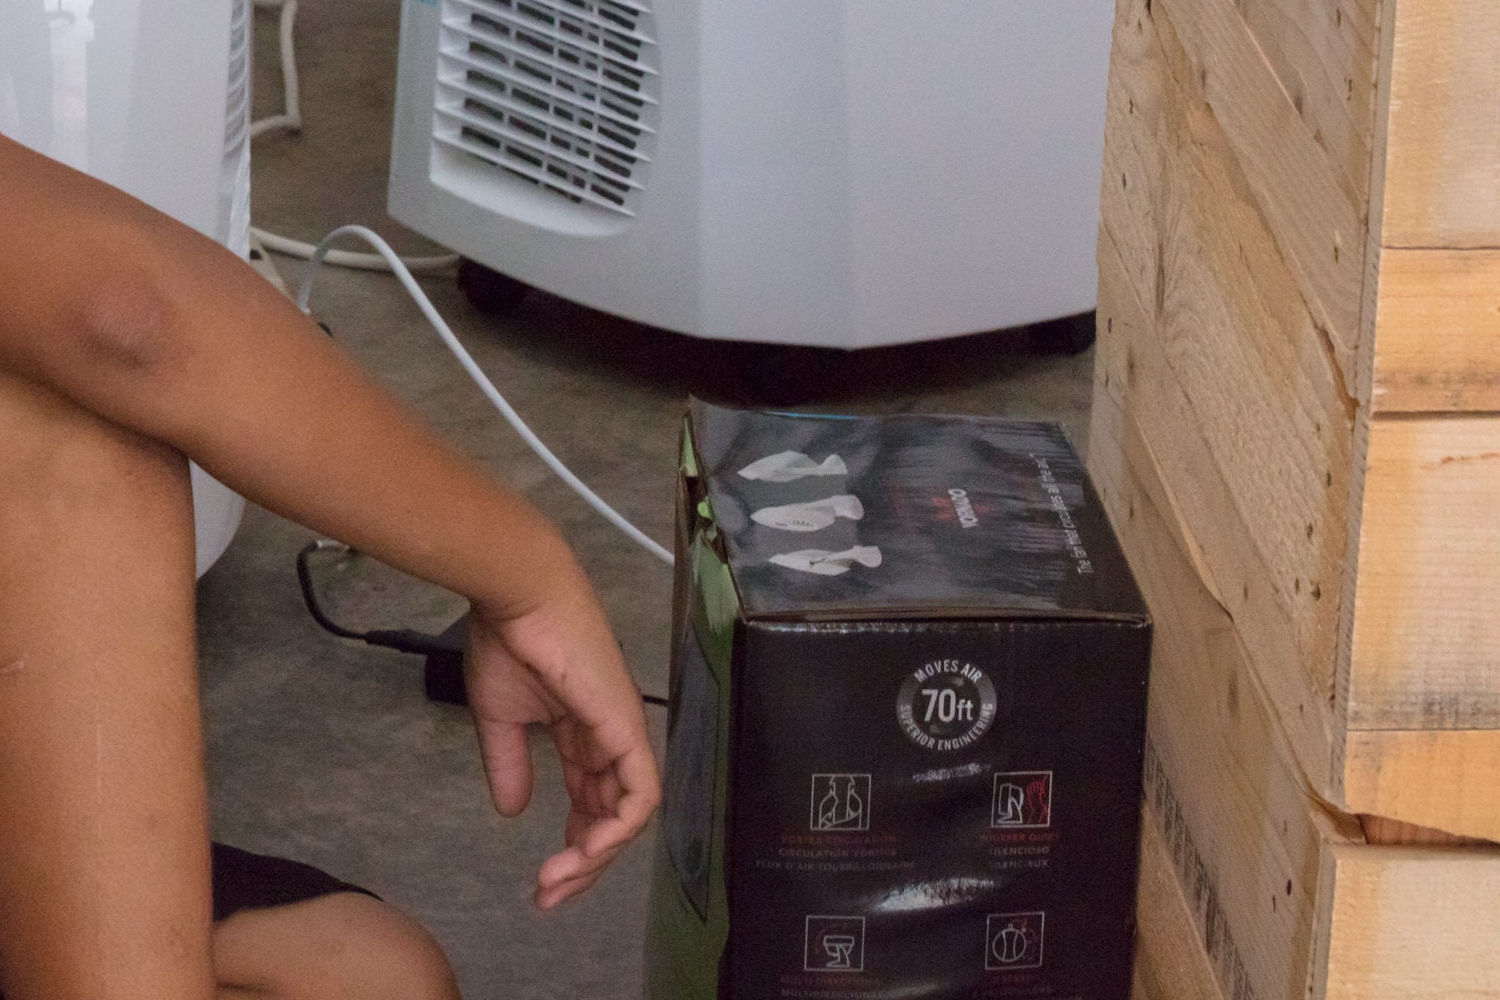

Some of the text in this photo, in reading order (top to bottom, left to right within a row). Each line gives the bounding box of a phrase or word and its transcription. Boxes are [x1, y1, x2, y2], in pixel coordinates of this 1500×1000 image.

[913, 659, 983, 684] MOVES AIR
[921, 689, 975, 723] 70ft
[900, 702, 994, 751] SUPERIOR ENGINEERING
